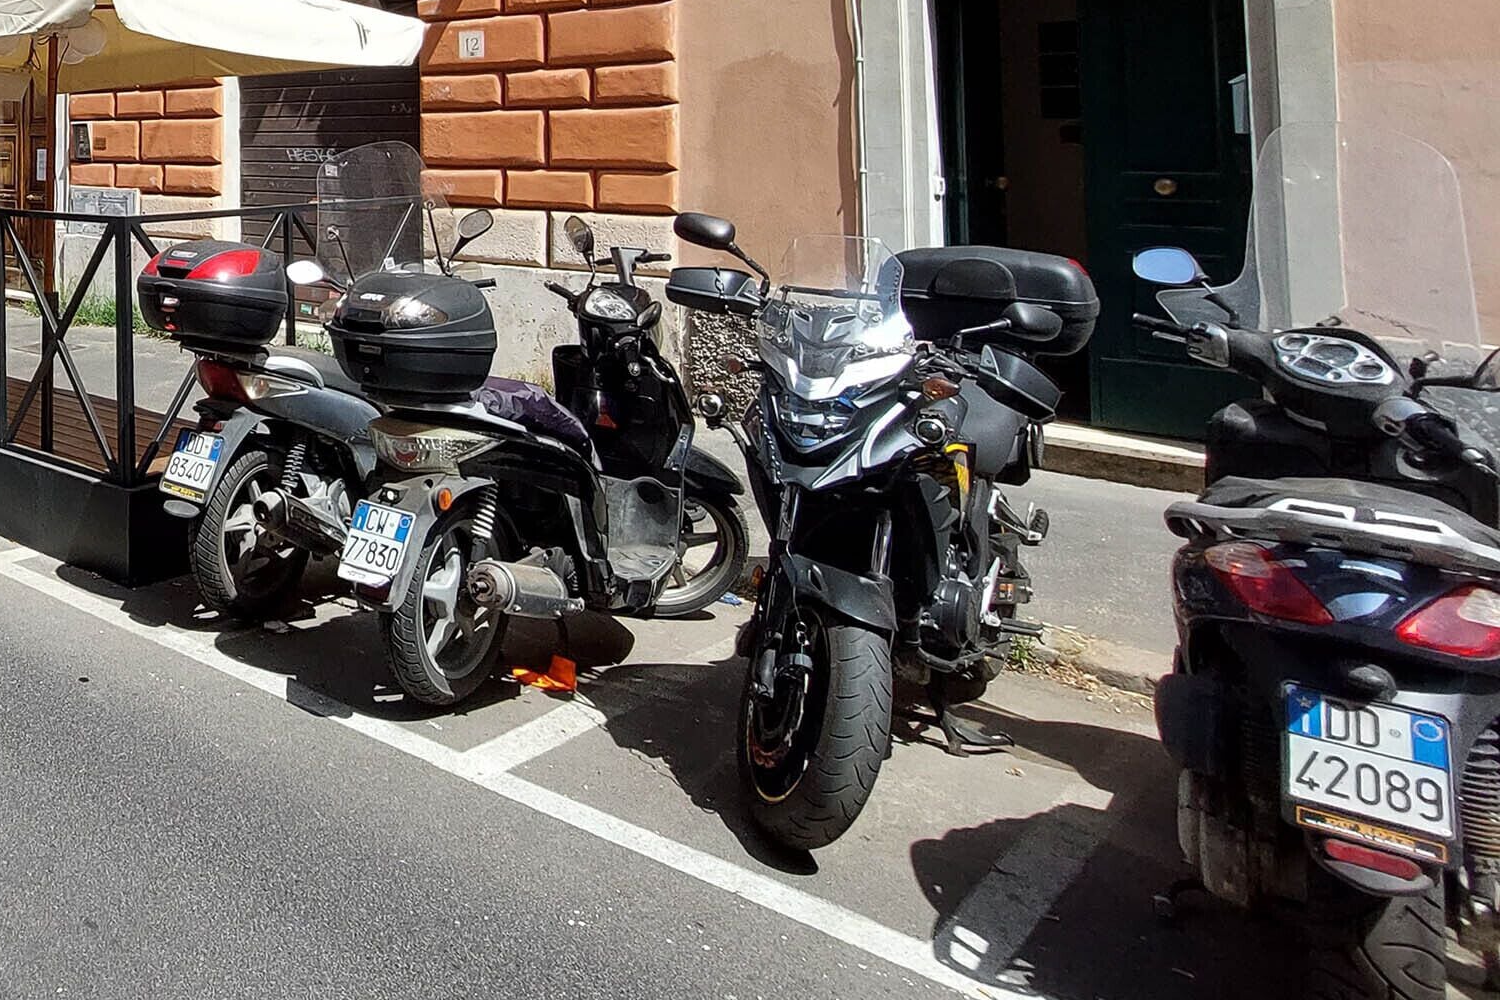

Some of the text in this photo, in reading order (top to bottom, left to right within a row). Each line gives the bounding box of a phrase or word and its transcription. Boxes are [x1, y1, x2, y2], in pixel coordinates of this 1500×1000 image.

[465, 37, 480, 51] 12
[186, 432, 205, 455] DD
[169, 456, 213, 484] 83407
[365, 508, 390, 534] CW
[345, 535, 399, 571] 77830
[1325, 700, 1380, 748] DD
[1295, 750, 1444, 822] 42089
